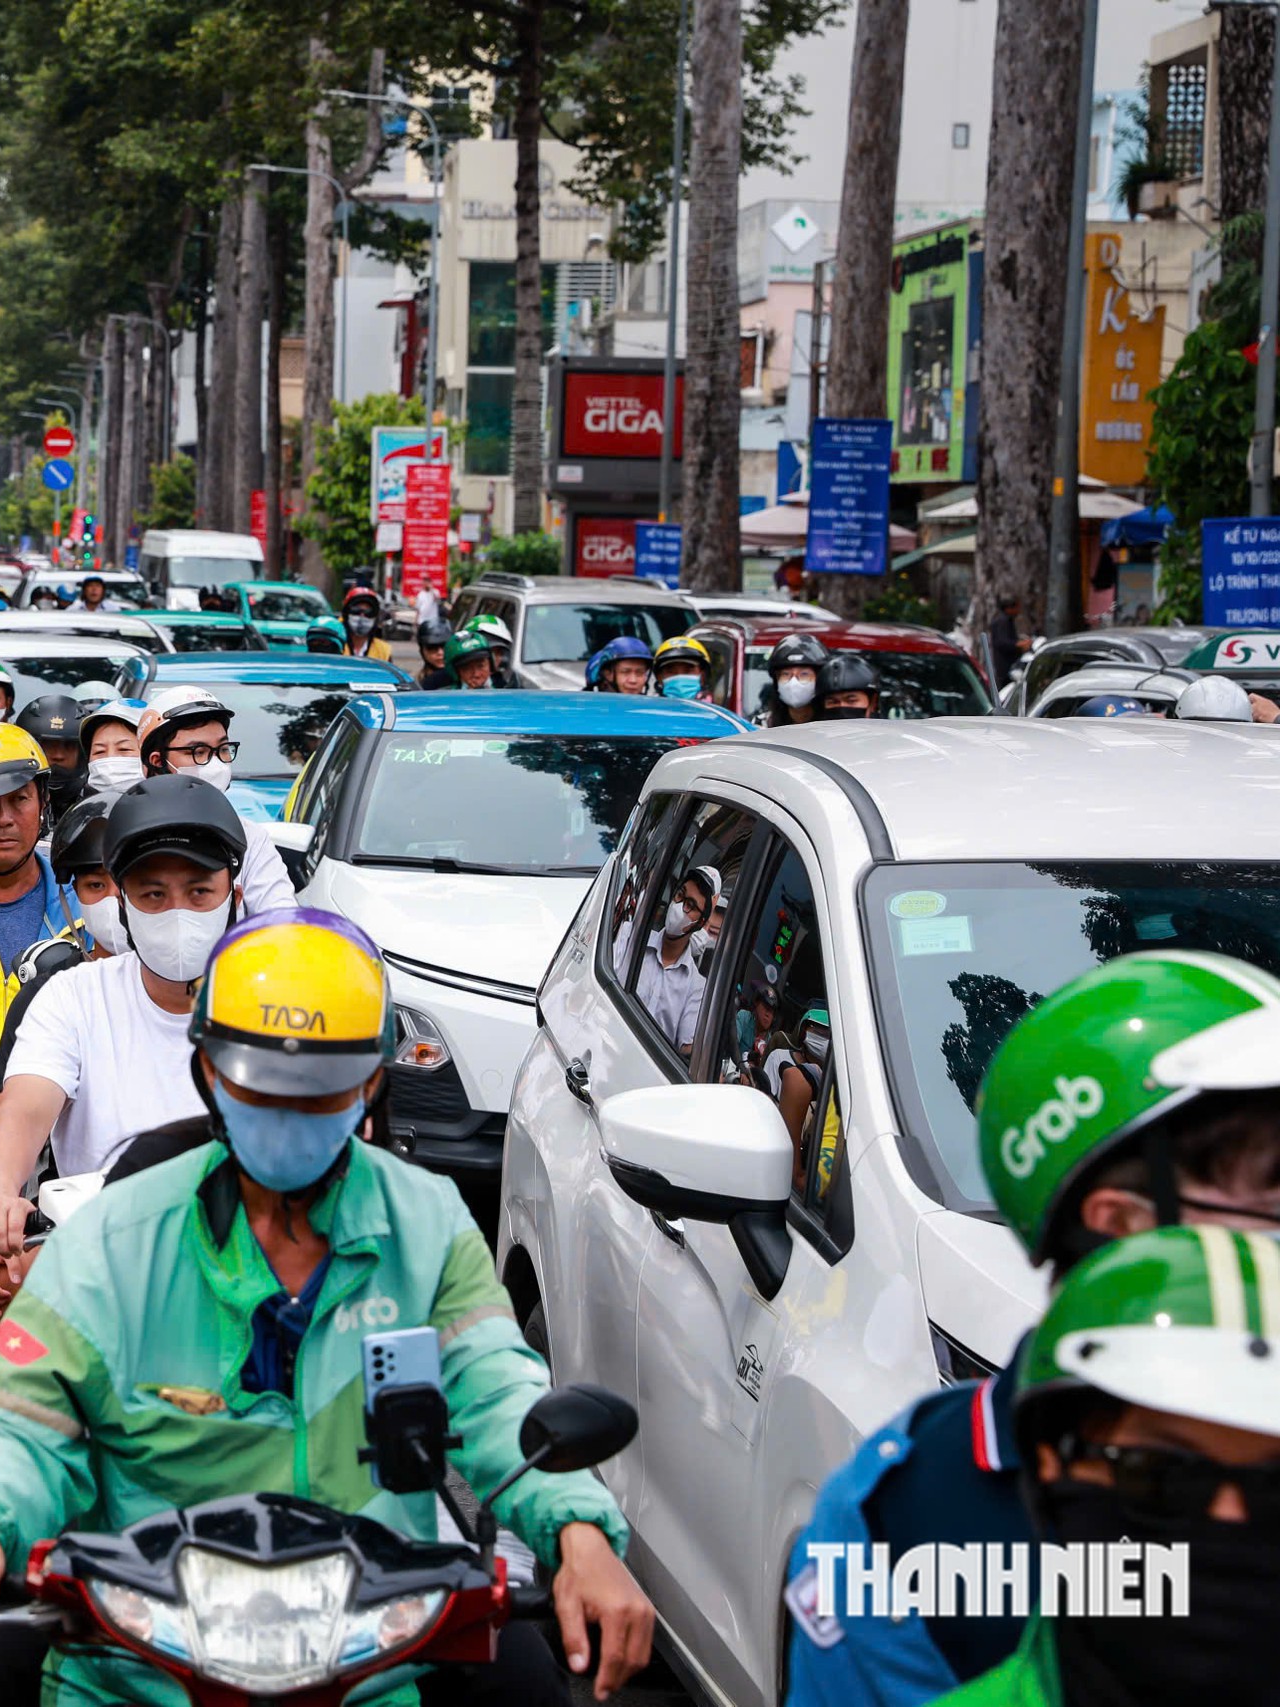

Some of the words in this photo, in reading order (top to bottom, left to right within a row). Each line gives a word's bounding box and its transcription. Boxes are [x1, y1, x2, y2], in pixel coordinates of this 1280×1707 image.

[586, 397, 642, 410] VIETTEL
[585, 409, 664, 434] GIGA
[393, 748, 447, 765] TAXI
[260, 1004, 326, 1034] TADA
[1002, 1075, 1104, 1179] Grab
